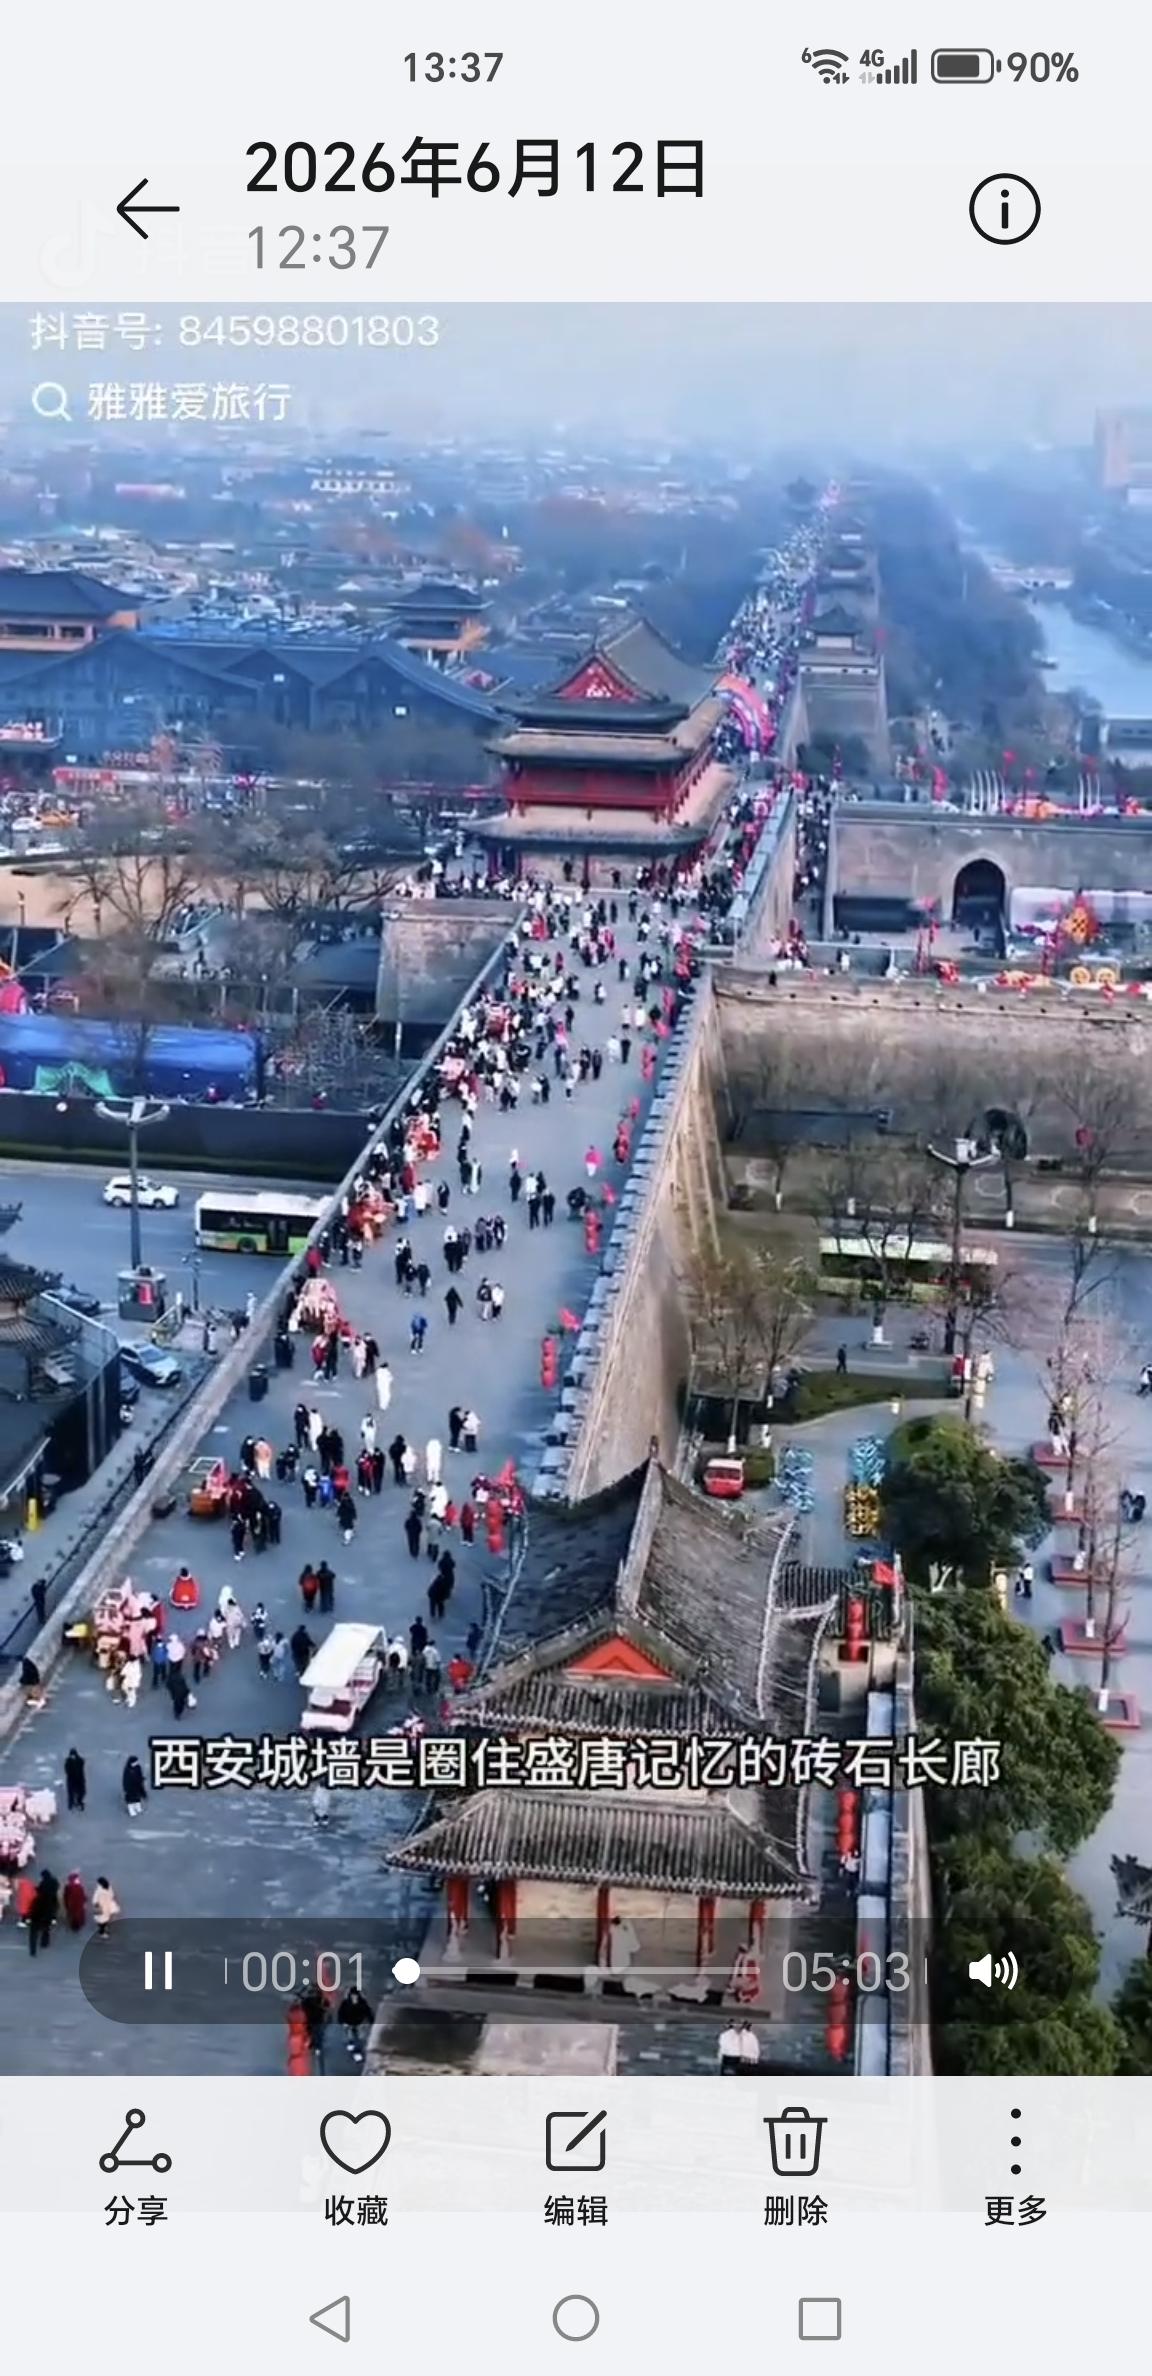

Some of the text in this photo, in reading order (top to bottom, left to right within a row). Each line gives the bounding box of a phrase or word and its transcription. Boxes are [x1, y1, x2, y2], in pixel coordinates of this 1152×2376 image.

[404, 51, 504, 83] 13:37
[801, 48, 812, 64] 6
[859, 49, 885, 67] 4G
[1006, 51, 1080, 83] 90%
[245, 135, 704, 199] 2026年6月12日
[248, 224, 390, 270] 12:37
[240, 1951, 364, 1993] 00:01
[781, 1951, 911, 1993] 05:03
[104, 2194, 168, 2227] 分享
[324, 2194, 389, 2227] 收藏
[543, 2194, 608, 2227] 编辑
[764, 2194, 828, 2227] 删除
[984, 2194, 1047, 2227] 更多
